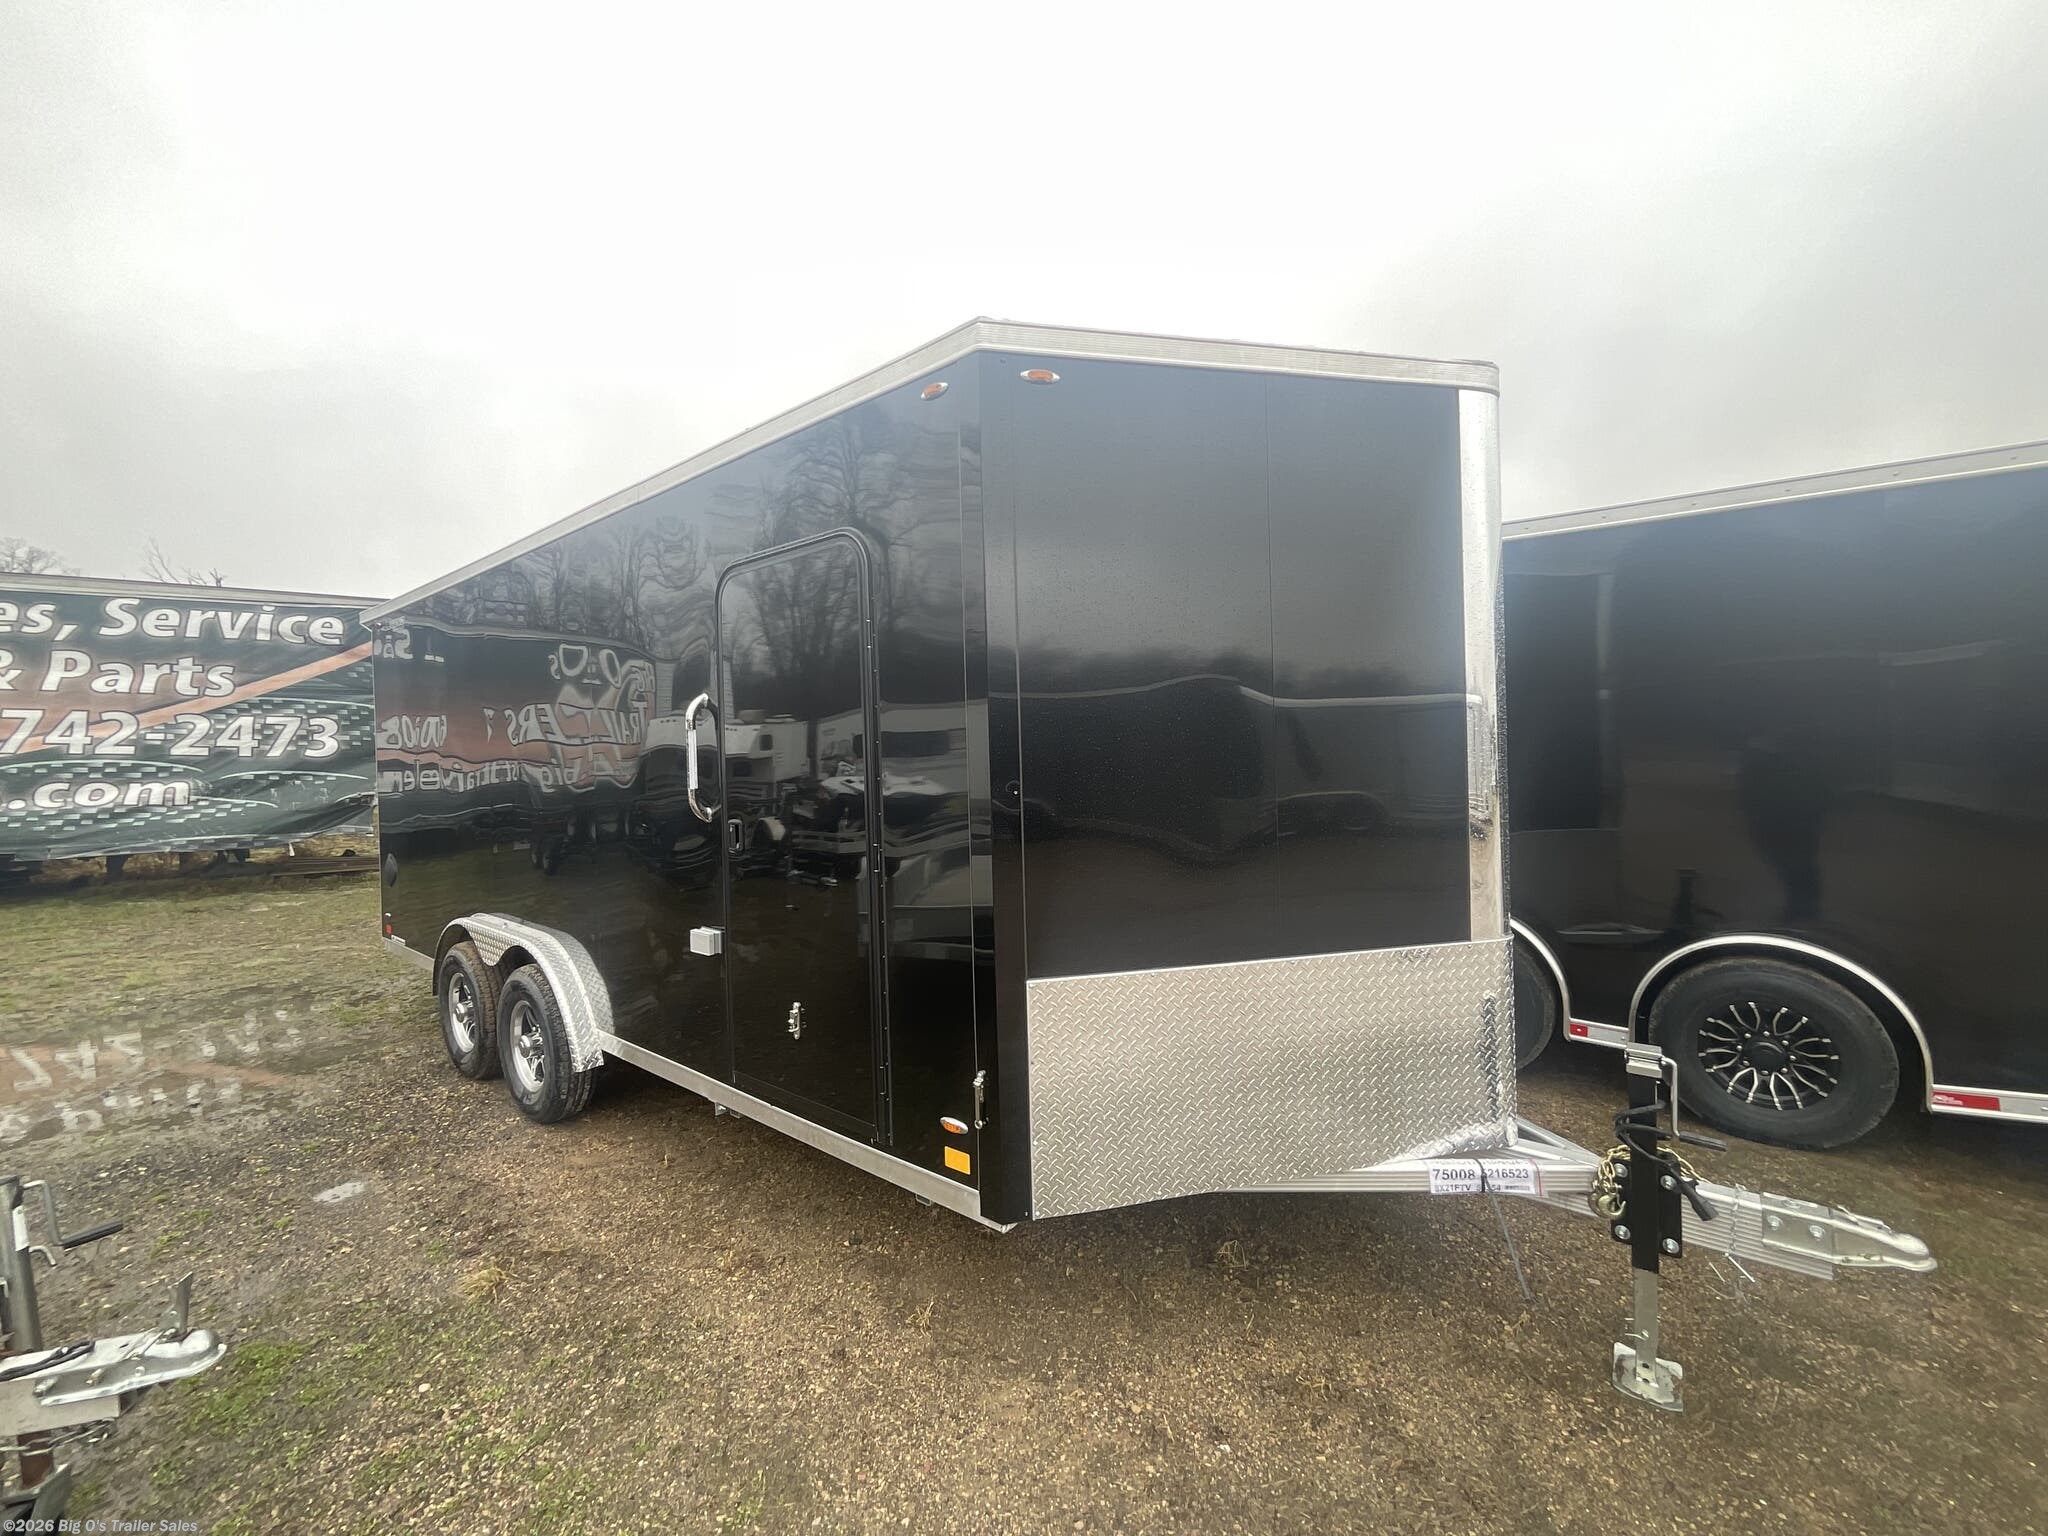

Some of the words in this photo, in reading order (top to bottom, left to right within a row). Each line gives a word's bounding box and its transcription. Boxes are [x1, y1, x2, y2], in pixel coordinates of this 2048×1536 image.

[99, 597, 345, 645] Service
[40, 649, 236, 698] Parts
[0, 708, 341, 758] 742-2473
[7, 780, 191, 810] .com
[1432, 1168, 1476, 1180] 75008
